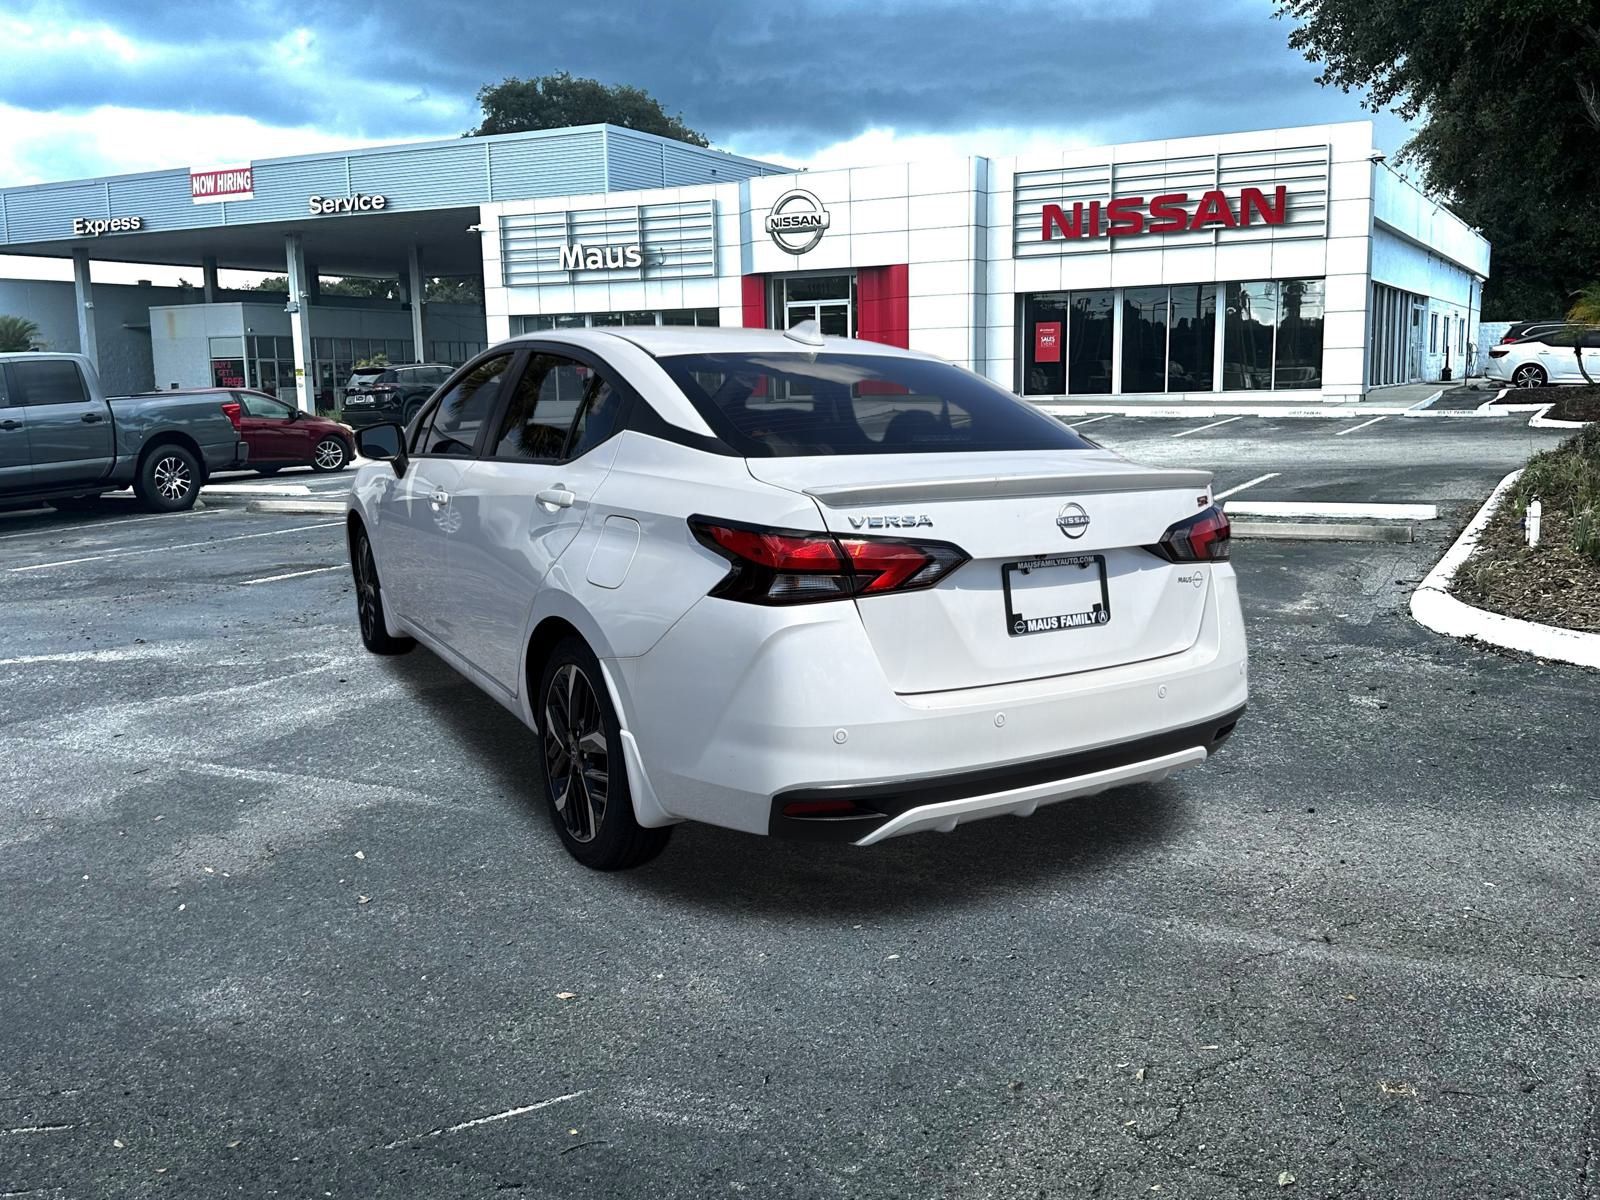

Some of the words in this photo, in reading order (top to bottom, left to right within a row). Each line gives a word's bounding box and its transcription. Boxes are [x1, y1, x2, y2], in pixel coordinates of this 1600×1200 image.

[193, 174, 215, 195] NOW
[217, 171, 251, 193] HIRING
[308, 193, 385, 215] Service
[1042, 185, 1286, 241] NISSAN
[73, 216, 141, 237] Express
[770, 215, 822, 229] NISSAN
[559, 243, 642, 270] Maus
[223, 377, 244, 387] FREE
[847, 514, 934, 530] VERSA
[1057, 515, 1090, 525] NISSAN
[1017, 555, 1095, 570] MAUSFAMILYAUTO.COM
[1177, 576, 1193, 584] MAUS
[1027, 615, 1059, 632] MAUS
[1060, 611, 1097, 628] FAMILY
